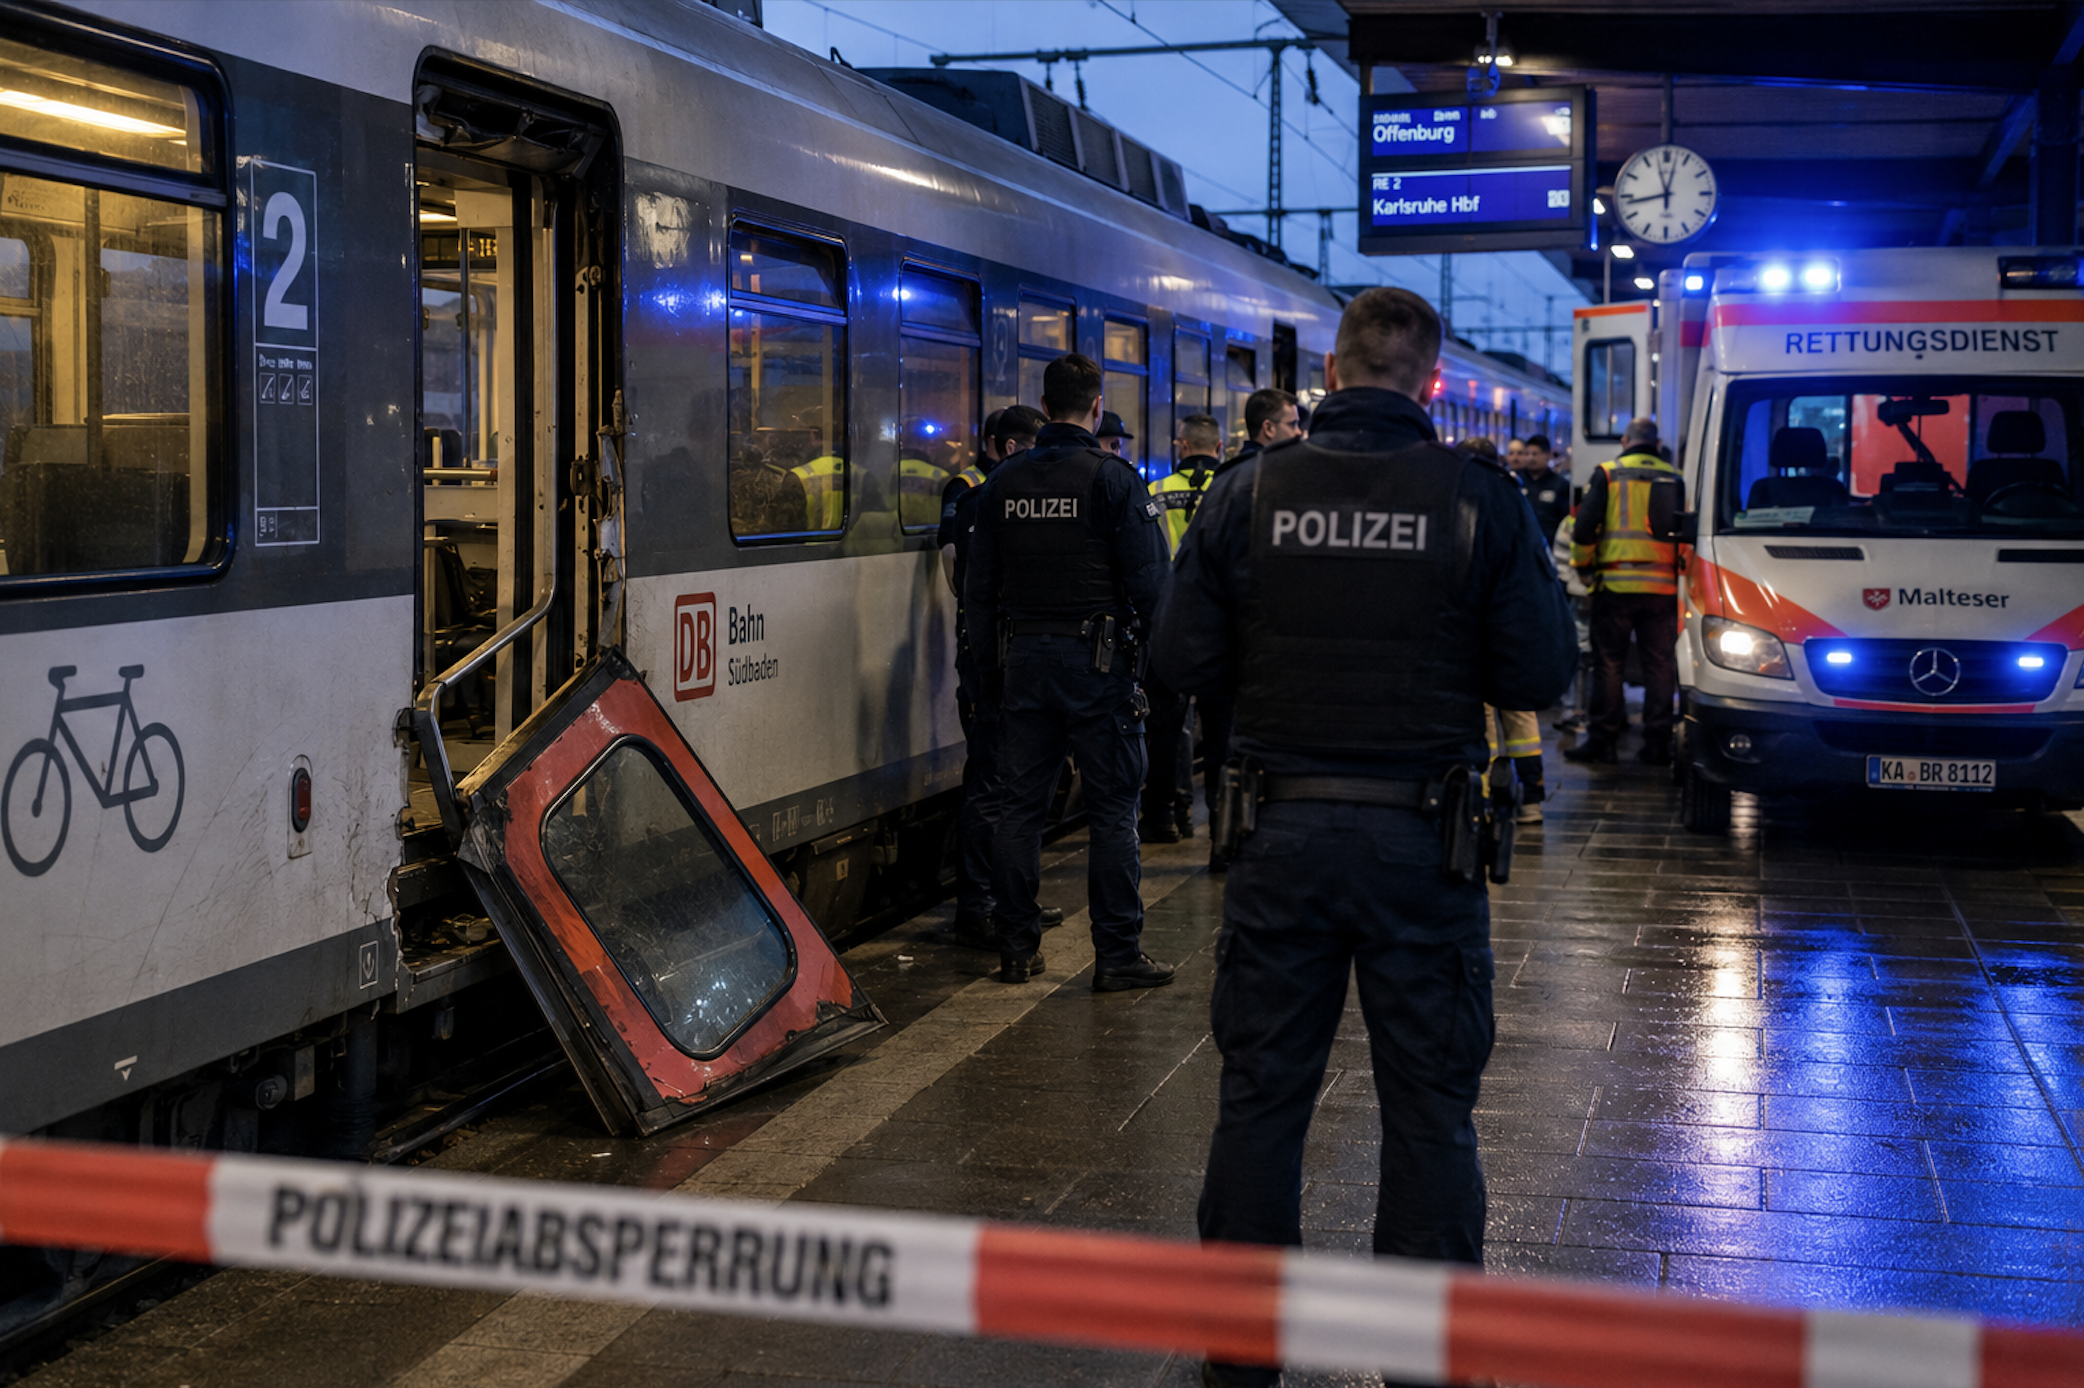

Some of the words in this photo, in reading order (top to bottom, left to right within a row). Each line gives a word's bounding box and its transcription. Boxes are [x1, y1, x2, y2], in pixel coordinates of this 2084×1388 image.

[1373, 123, 1455, 144] Offenburg
[1373, 177, 1390, 190] RE
[1393, 176, 1402, 190] 2
[1373, 197, 1448, 215] Karlsruhe
[1451, 195, 1480, 213] Hbf
[262, 191, 308, 331] 2
[1785, 329, 2059, 354] RETTUNGSDIENST
[1004, 498, 1078, 519] POLIZEI
[1271, 510, 1428, 551] POLIZEI
[1898, 588, 2010, 608] Malteser
[729, 604, 765, 645] Bahn
[680, 610, 711, 683] DB
[728, 653, 778, 686] Südbaden
[1881, 760, 1904, 781] KA
[1919, 762, 1943, 782] BR
[1948, 763, 1993, 784] 8112
[268, 1184, 896, 1307] POLIZEIABSPERRUNG
